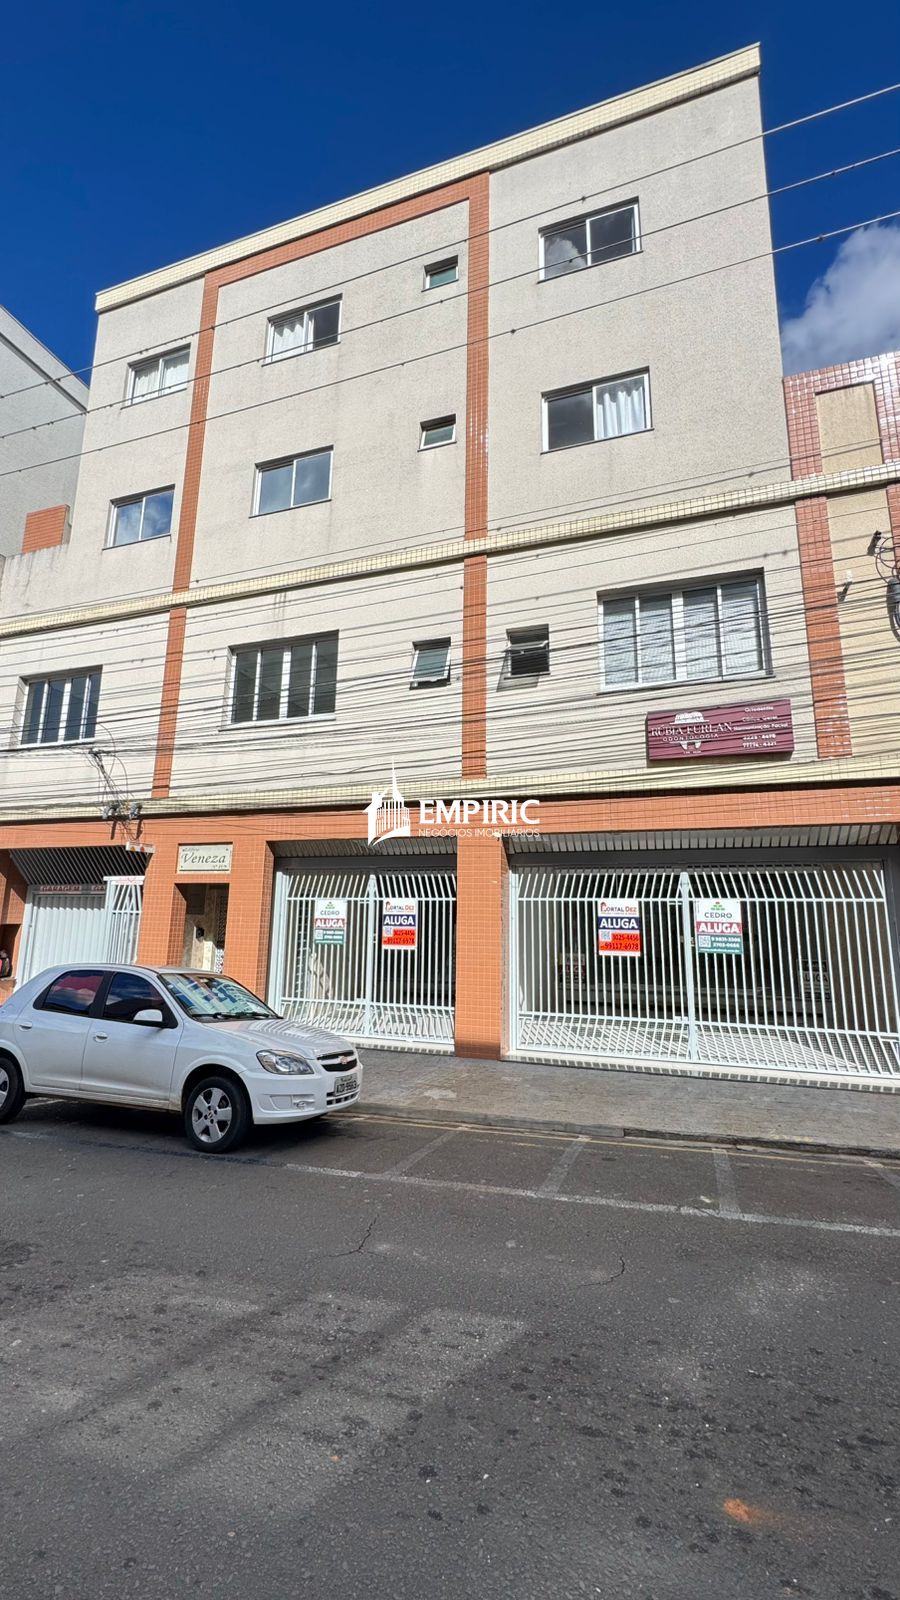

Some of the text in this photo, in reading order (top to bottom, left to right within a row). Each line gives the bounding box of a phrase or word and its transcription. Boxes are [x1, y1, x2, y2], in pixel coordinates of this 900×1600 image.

[686, 722, 732, 734] FURLAN
[663, 734, 719, 742] ODONTOLOGIA
[181, 852, 227, 864] Veneza
[315, 919, 344, 928] ALUGA
[384, 915, 414, 925] ALUGA
[600, 918, 639, 929] ALUGA
[699, 922, 740, 933] ALUGA
